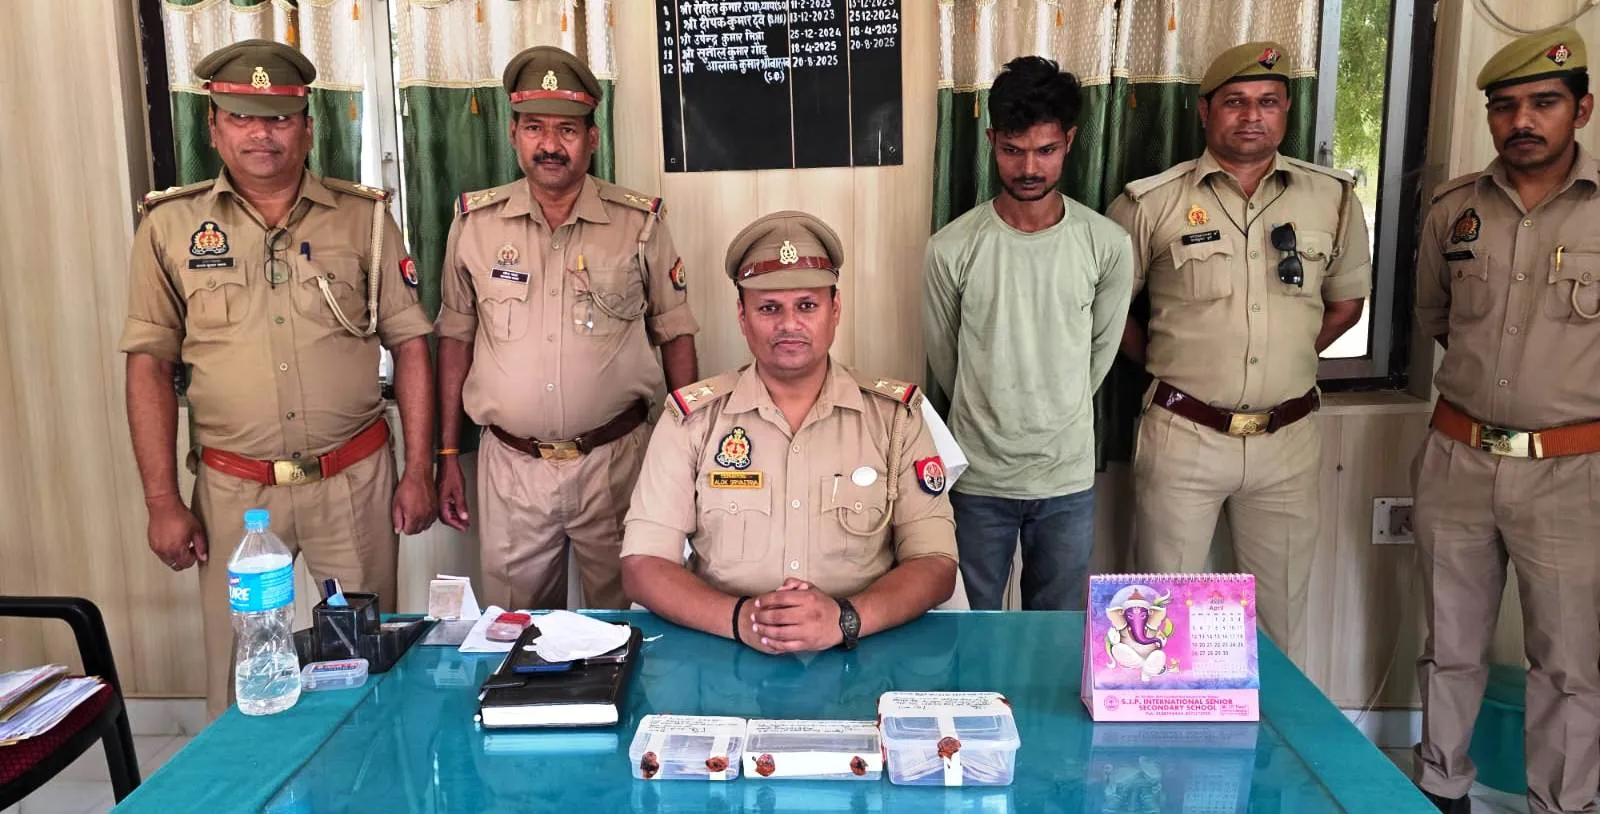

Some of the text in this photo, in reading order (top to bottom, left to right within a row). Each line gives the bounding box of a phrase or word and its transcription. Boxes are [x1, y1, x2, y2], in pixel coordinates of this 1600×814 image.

[719, 2, 742, 15] कुमार
[663, 37, 674, 46] 10
[663, 49, 673, 60] 11
[663, 63, 674, 74] 12
